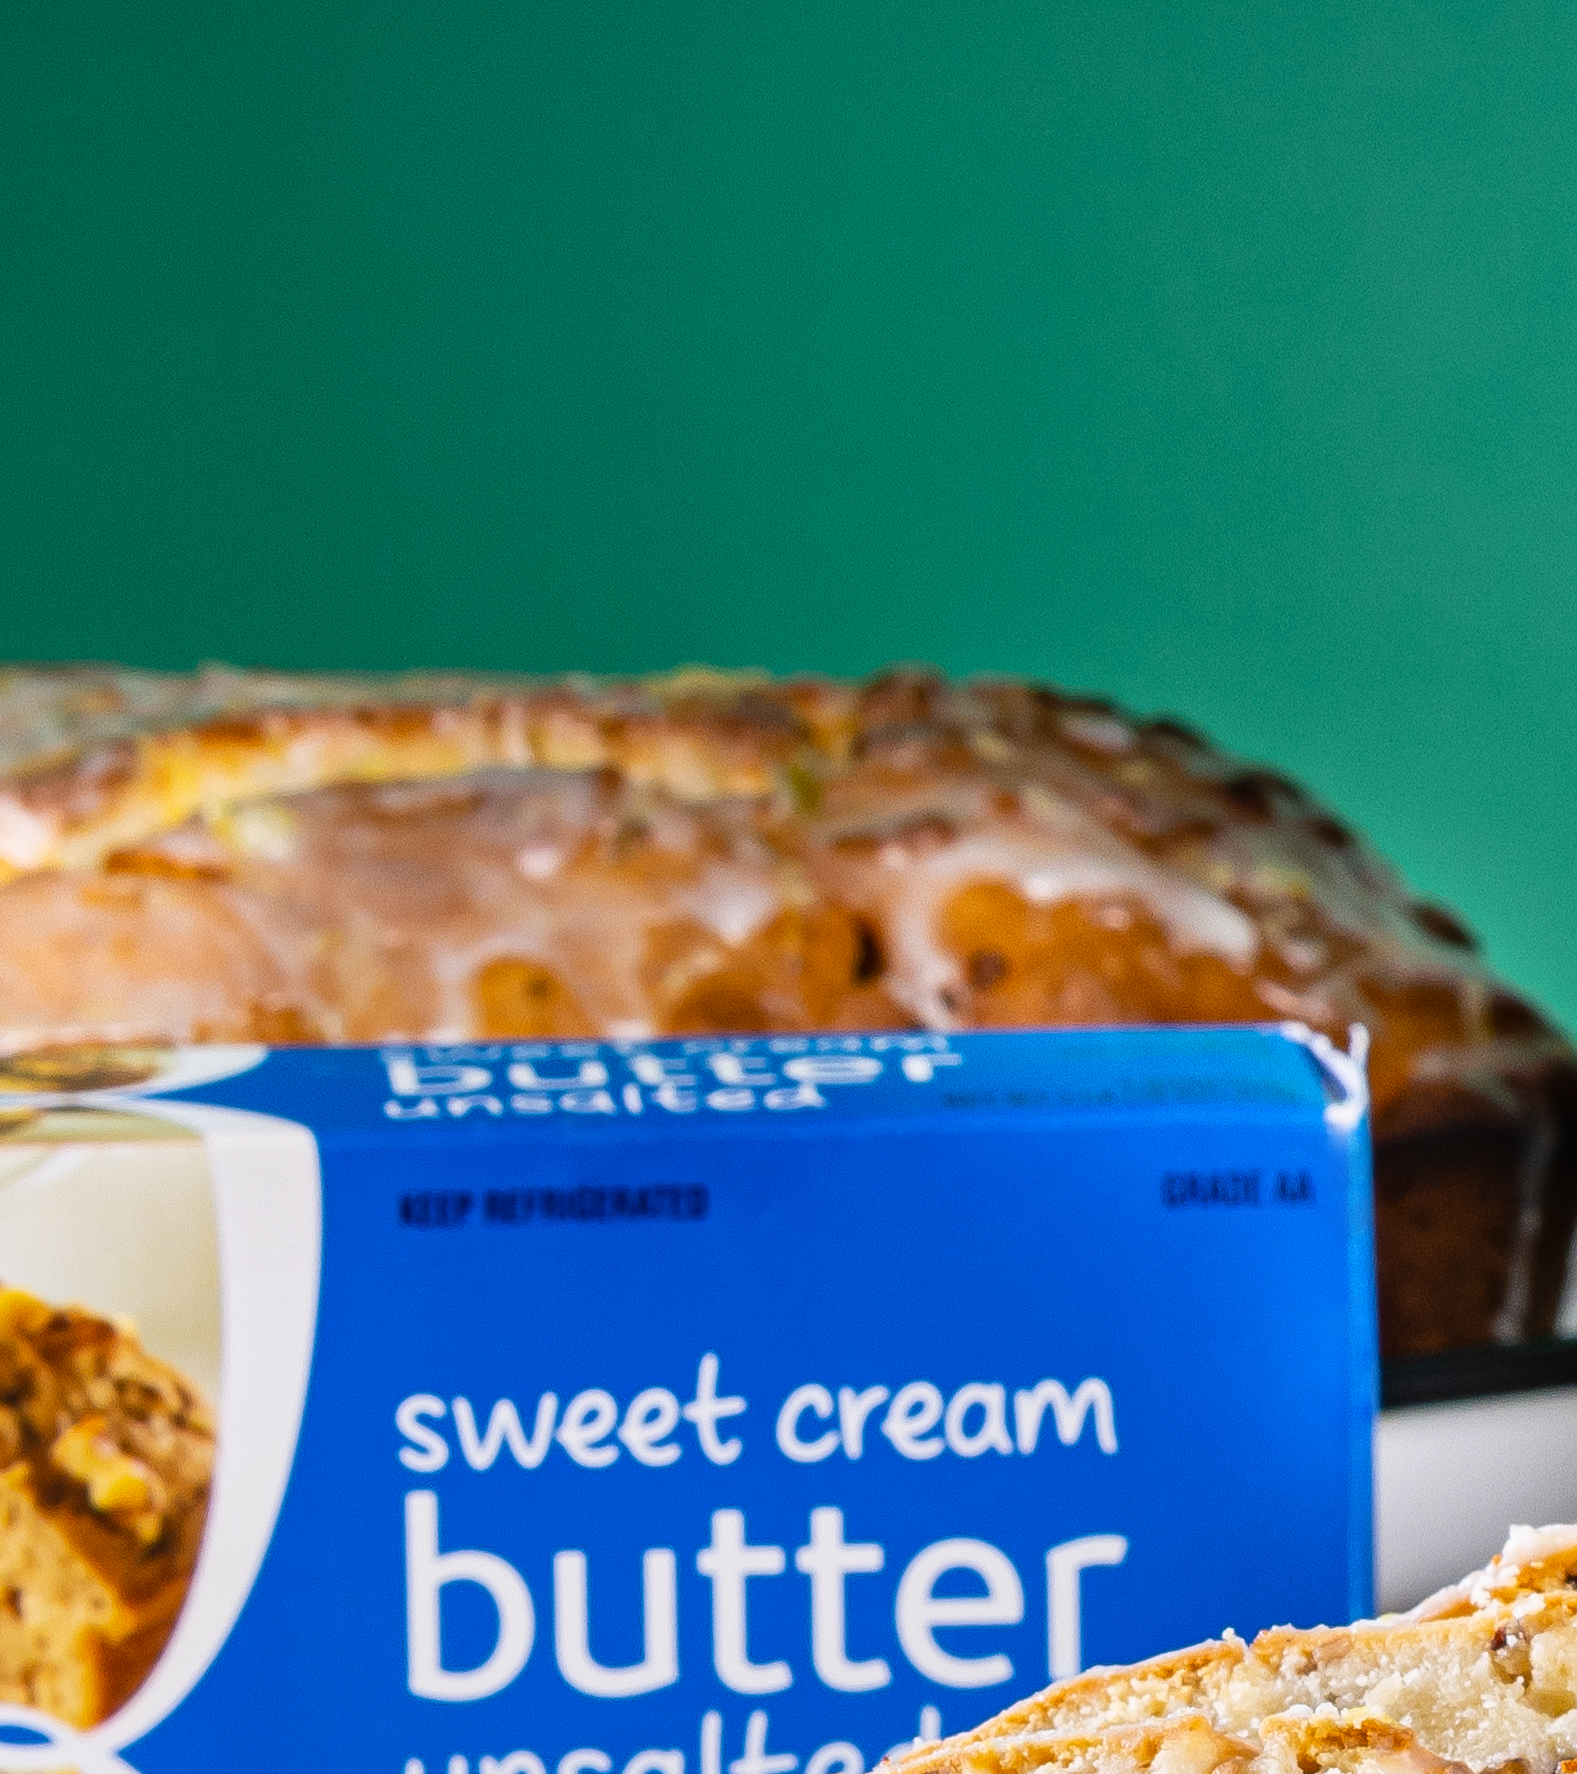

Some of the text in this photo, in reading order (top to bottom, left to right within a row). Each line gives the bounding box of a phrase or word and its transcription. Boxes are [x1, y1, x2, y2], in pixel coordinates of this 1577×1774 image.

[384, 1053, 963, 1097] butter
[382, 1083, 826, 1120] unsalted
[398, 1189, 473, 1229] KEEP
[1160, 1168, 1261, 1211] GRADE
[394, 1352, 1120, 1473] sweet cream
[404, 1490, 1129, 1703] butter
